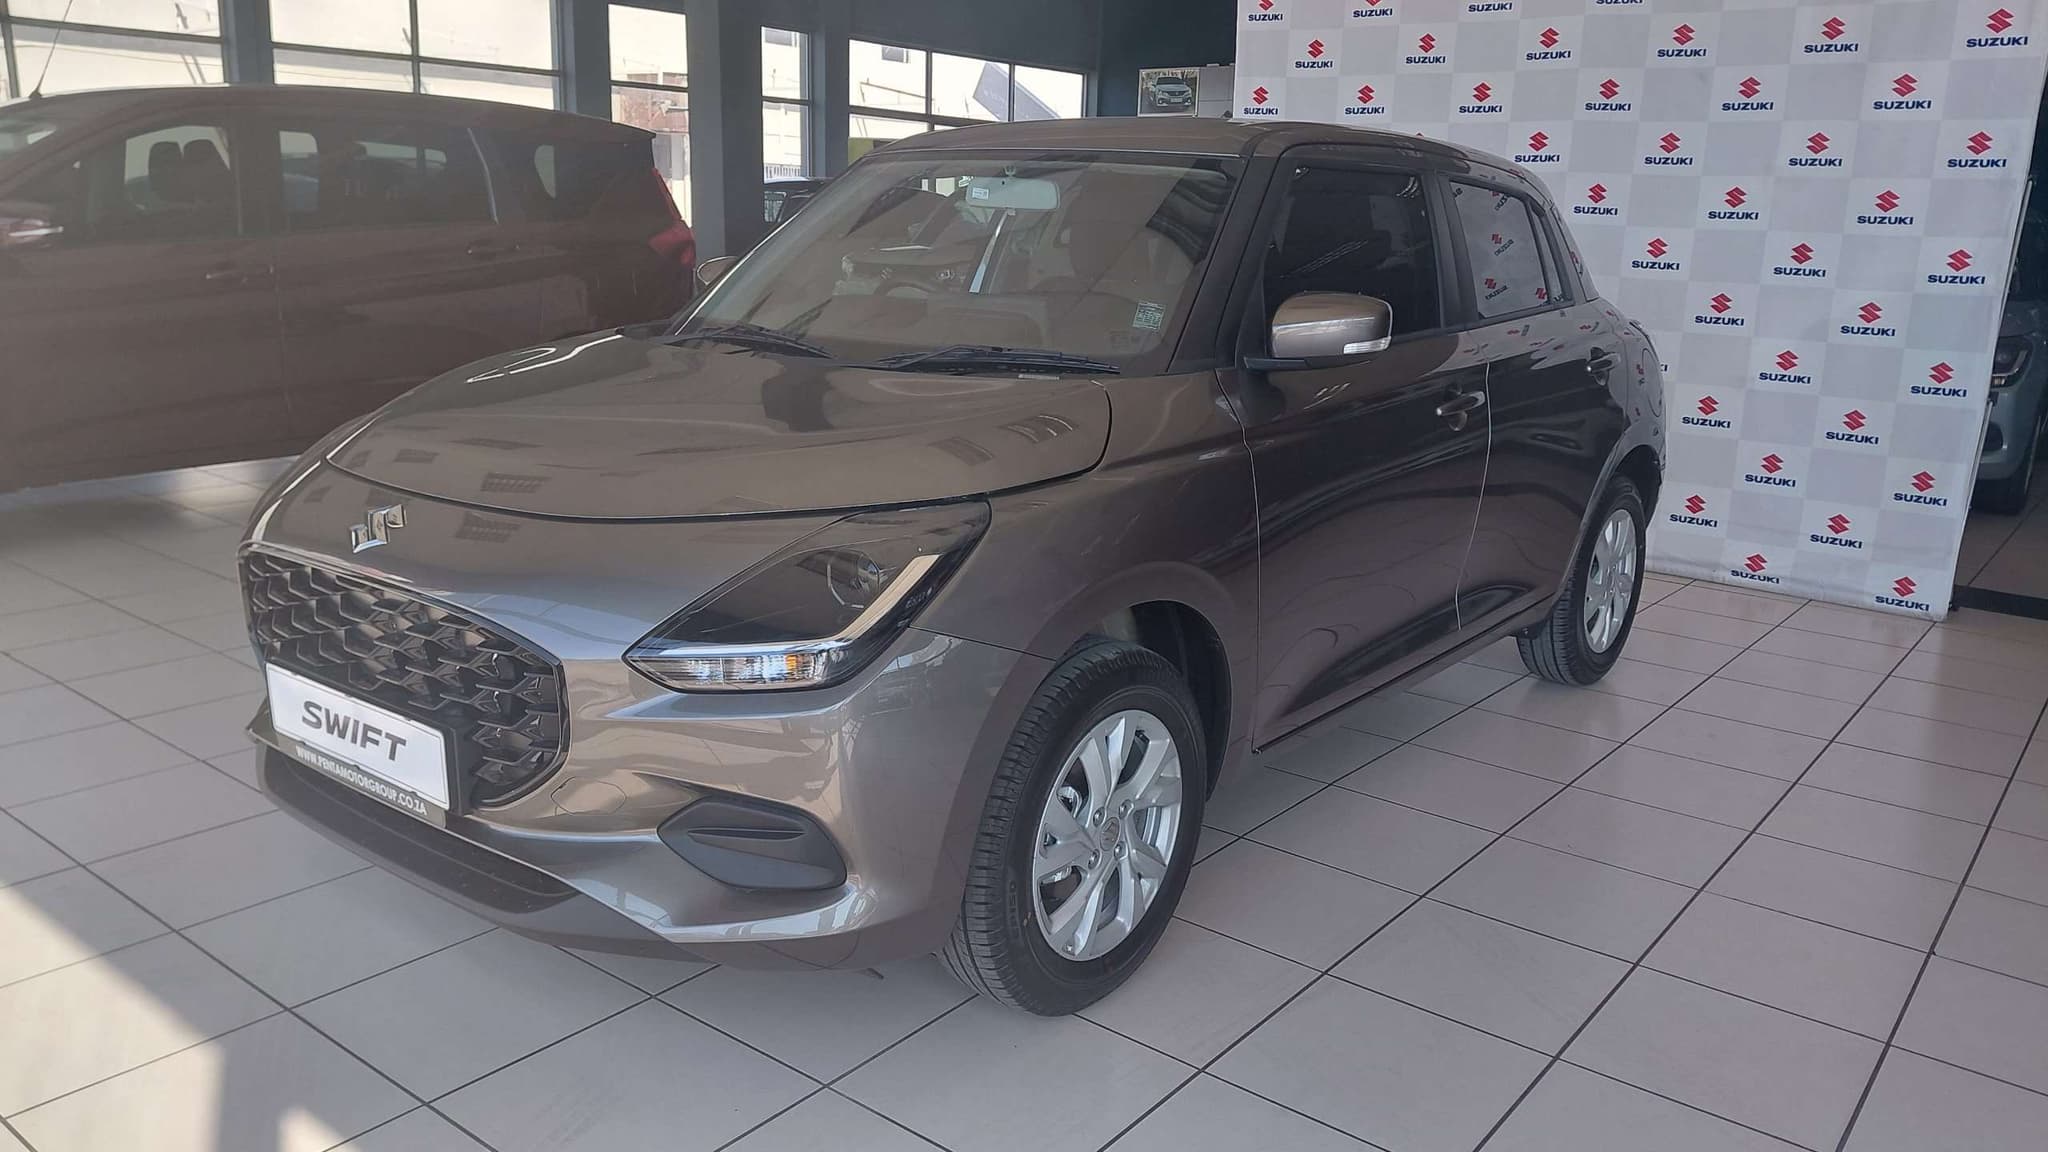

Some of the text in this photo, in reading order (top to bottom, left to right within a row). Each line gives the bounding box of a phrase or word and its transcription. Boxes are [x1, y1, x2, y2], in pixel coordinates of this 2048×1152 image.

[1352, 8, 1393, 18] SUZUKI
[1468, 2, 1513, 13] SUZUKI
[1248, 13, 1284, 22] SUZUKI
[1966, 35, 2029, 48] SUZUKI
[1656, 48, 1707, 58] SUZUKI
[1803, 42, 1859, 54] SUZUKI
[1405, 55, 1446, 65] SUZUKI
[1525, 50, 1572, 61] SUZUKI
[1294, 60, 1333, 69] SUZUKI
[1458, 105, 1503, 114] SUZUKI
[1584, 102, 1632, 112] SUZUKI
[1721, 101, 1774, 112] SUZUKI
[1872, 99, 1932, 110] SUZUKI
[1243, 107, 1279, 116] SUZUKI
[1344, 106, 1385, 115] SUZUKI
[1514, 154, 1561, 164] SUZUKI
[1644, 156, 1694, 166] SUZUKI
[1788, 157, 1843, 167] SUZUKI
[1946, 158, 2008, 169] SUZUKI
[1573, 205, 1619, 217] SUZUKI
[1707, 210, 1760, 221] SUZUKI
[1856, 215, 1914, 226] SUZUKI
[1631, 260, 1681, 271] SUZUKI
[1773, 266, 1827, 278] SUZUKI
[1927, 274, 1986, 285] SUZUKI
[1694, 315, 1745, 327] SUZUKI
[1839, 325, 1896, 337] SUZUKI
[1758, 372, 1812, 385] SUZUKI
[1910, 385, 1968, 398] SUZUKI
[1681, 415, 1732, 430] SUZUKI
[1825, 431, 1880, 445] SUZUKI
[1744, 473, 1797, 488] SUZUKI
[1893, 492, 1948, 507] SUZUKI
[1669, 513, 1718, 529] SUZUKI
[1809, 533, 1863, 550] SUZUKI
[1730, 569, 1780, 585] SUZUKI
[1874, 595, 1931, 613] SUZUKI
[302, 700, 407, 761] SWIFT
[296, 745, 428, 816] WWW.PENTAMOTORGROUP.CO.ZA
